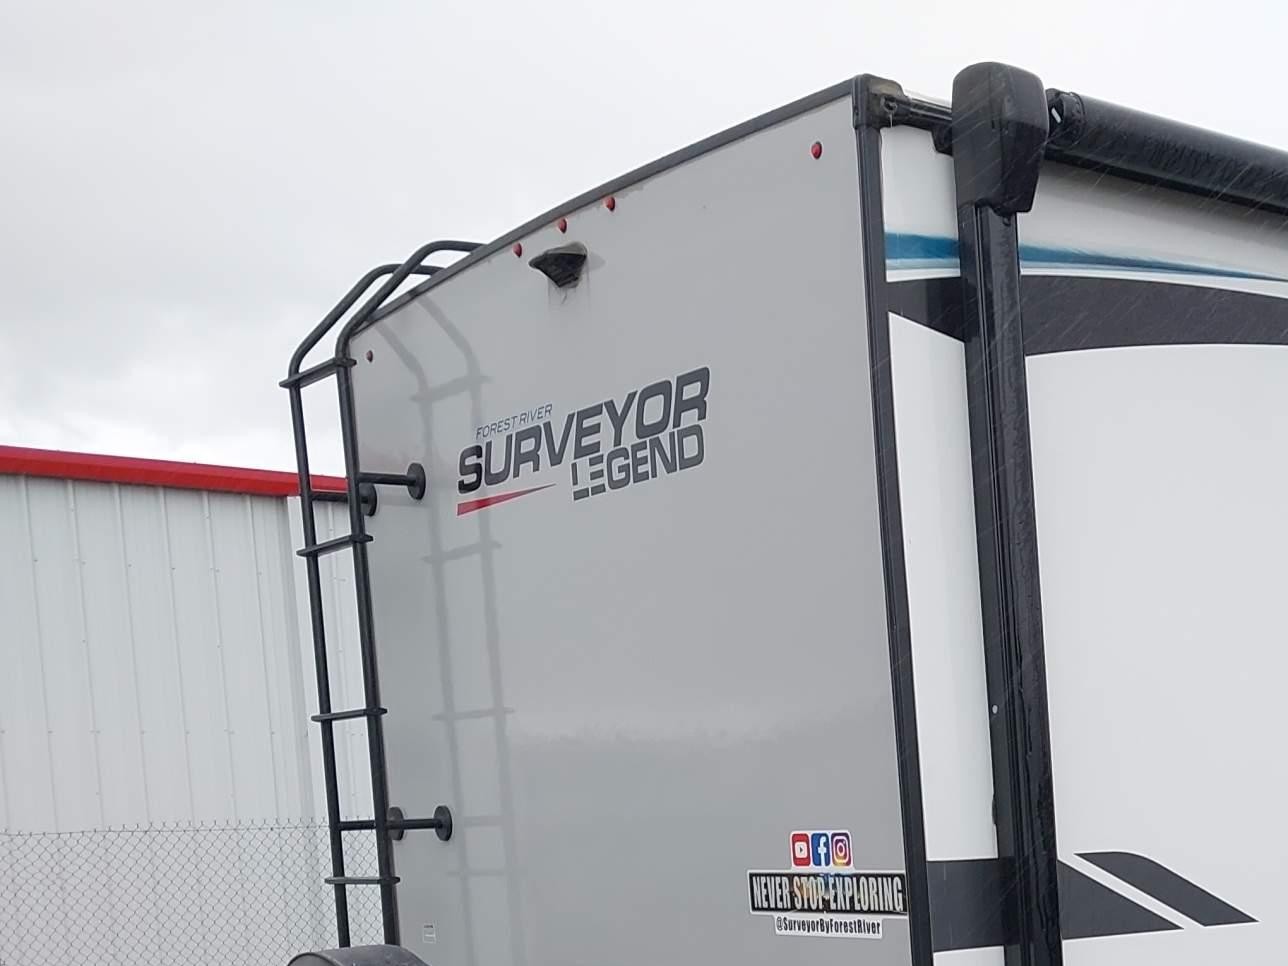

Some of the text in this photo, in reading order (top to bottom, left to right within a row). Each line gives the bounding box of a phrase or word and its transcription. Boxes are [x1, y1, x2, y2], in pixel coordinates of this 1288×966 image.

[457, 366, 710, 495] SURVEYOR
[475, 403, 553, 439] FOREST RIVER
[571, 424, 705, 501] LEGEND
[752, 875, 904, 912] NEVER STOP EXPLORING
[776, 916, 881, 935] @SurveyorByForestRiver
